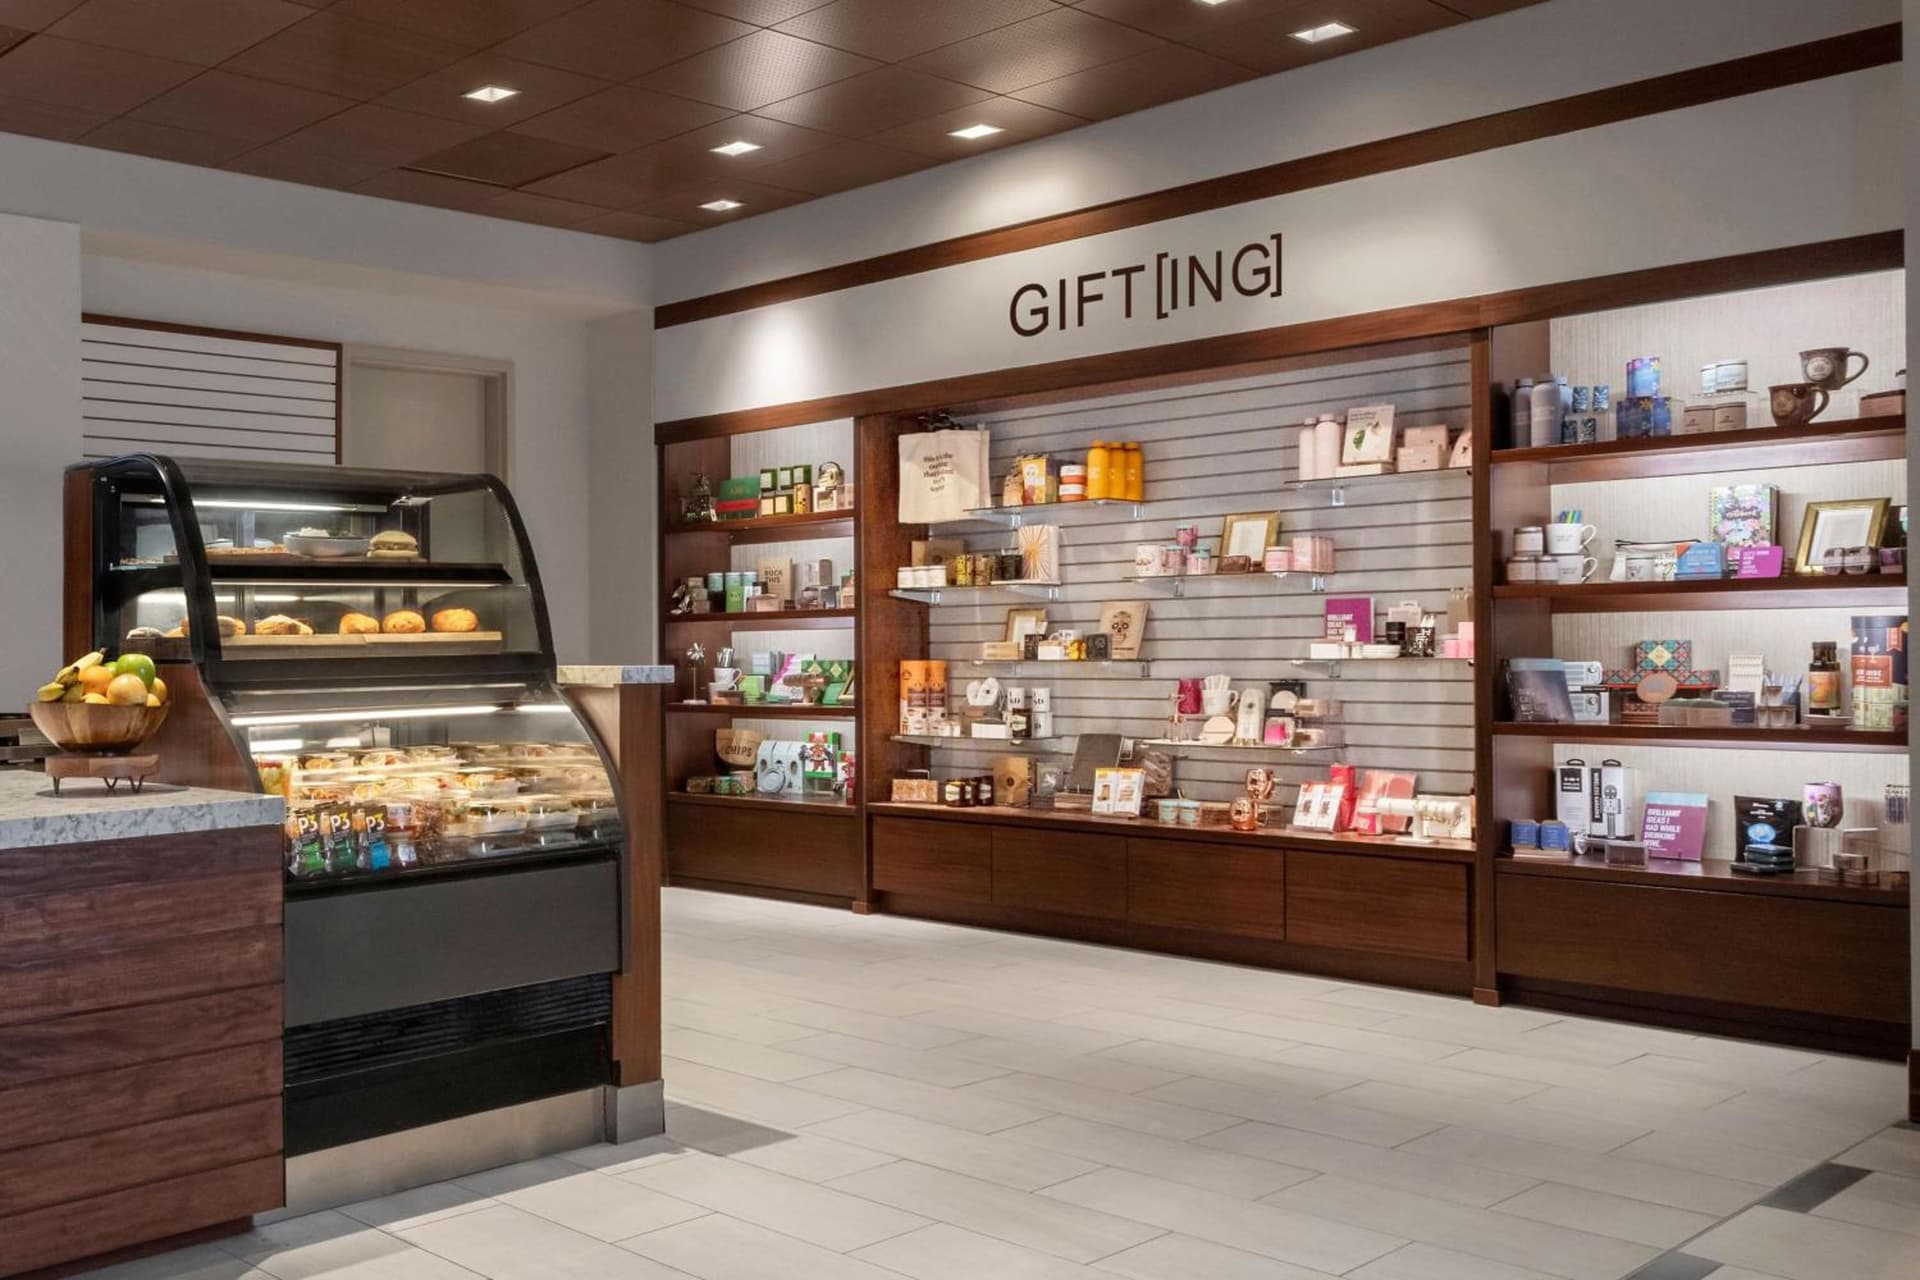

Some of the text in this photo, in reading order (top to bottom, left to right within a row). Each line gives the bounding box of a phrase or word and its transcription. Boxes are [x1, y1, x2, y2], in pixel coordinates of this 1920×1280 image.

[725, 743, 753, 758] CHIPS
[1647, 808, 1681, 818] BRILLIANT
[298, 813, 318, 834] P3
[330, 811, 350, 832] P3
[366, 812, 385, 833] P3
[1646, 816, 1666, 825] IDEAS
[1645, 824, 1681, 833] HAD WHILE
[1643, 832, 1676, 841] DRINKING
